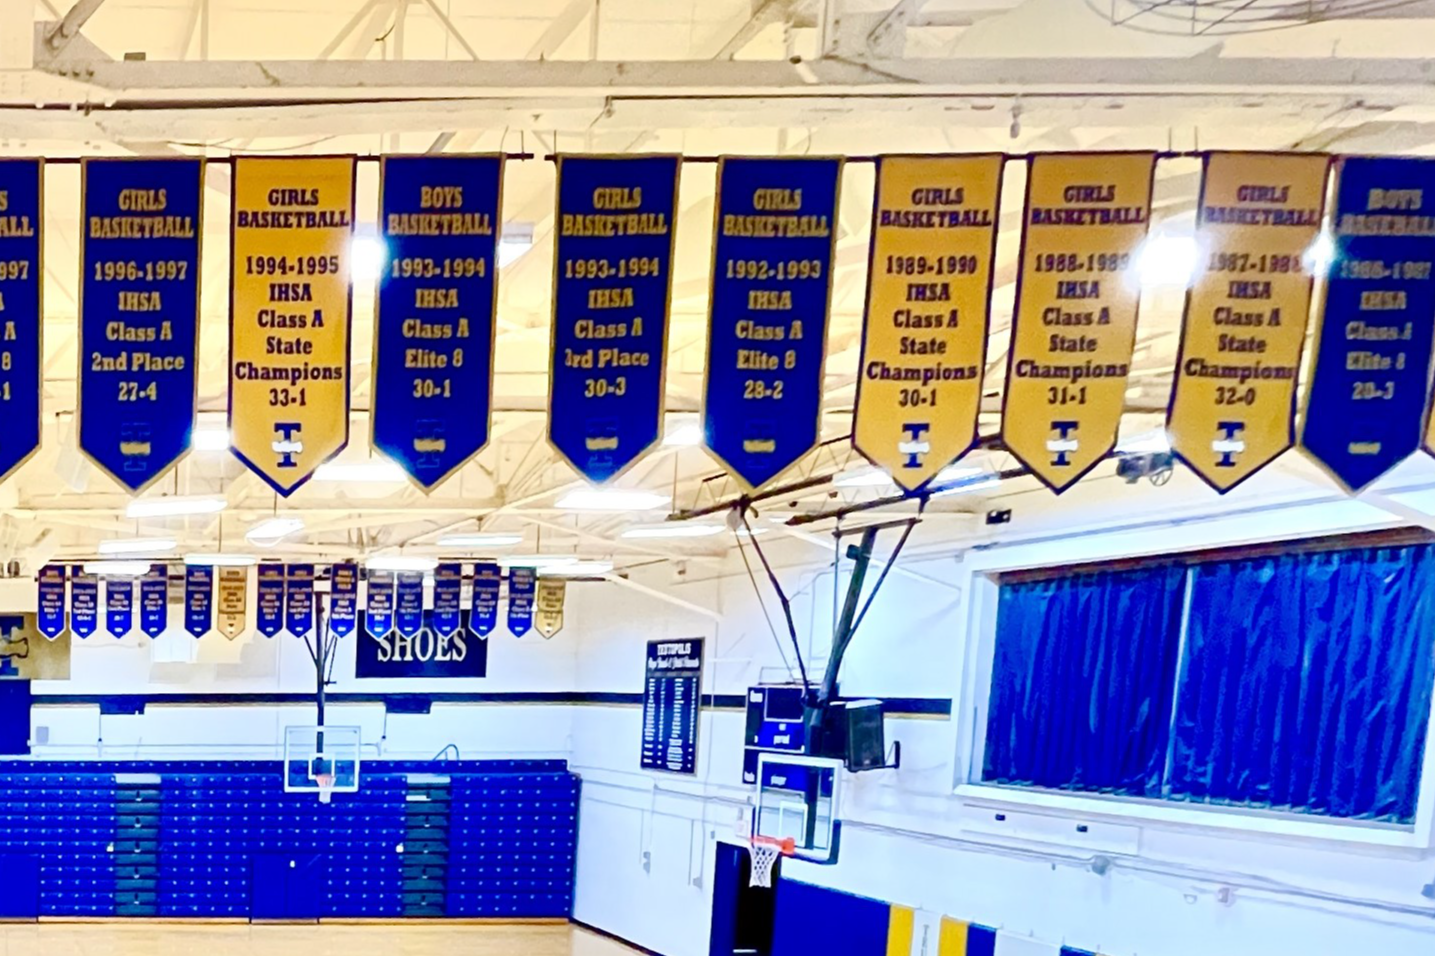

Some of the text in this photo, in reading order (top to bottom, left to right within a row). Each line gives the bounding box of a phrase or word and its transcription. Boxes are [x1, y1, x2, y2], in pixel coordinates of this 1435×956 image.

[119, 189, 166, 211] GIRLS
[268, 189, 318, 206] GIRLS
[421, 186, 462, 208] BOYS
[593, 187, 641, 209] GIRLS
[753, 189, 801, 210] GIRLS
[912, 188, 963, 205] GIRLS
[1064, 185, 1115, 203] GIRLS
[237, 211, 349, 228] BASKETBALL
[387, 213, 492, 235] BASKETBALL
[562, 214, 667, 236] BASKETBALL
[880, 209, 992, 228] BASKETBALL
[1031, 207, 1145, 225] BASKETBALL
[90, 216, 194, 238] BASKETBALL
[723, 215, 829, 237] BASKETBALL
[95, 261, 187, 281] 1996-1997
[247, 256, 338, 275] 1994-1995
[393, 258, 485, 277] 1993-1994
[566, 257, 658, 278] 1993-1994
[727, 260, 821, 280] 1992-1993
[887, 255, 977, 275] 1989-1990
[270, 283, 312, 301] IHSA
[415, 289, 458, 308] IHSA
[588, 288, 633, 308] IHSA
[906, 283, 950, 301] IHSA
[1056, 281, 1099, 299] IHSA
[118, 292, 161, 311] IHSA
[748, 291, 792, 309] IHSA
[258, 310, 323, 328] Class A
[893, 309, 958, 328] Class A
[1042, 307, 1110, 326] Class A
[4, 321, 16, 340] A
[106, 321, 172, 341] Class A
[403, 318, 469, 338] Class A
[575, 317, 642, 338] Class A
[736, 320, 802, 340] Class A
[267, 336, 312, 354] State
[900, 337, 946, 355] State
[1049, 334, 1097, 352] State
[2, 352, 11, 370] 8
[92, 352, 184, 371] 2nd Place
[405, 349, 463, 368] Elite 8
[598, 348, 649, 368] Place
[737, 350, 795, 369] Elite 8
[235, 362, 342, 386] Champions
[867, 361, 978, 386] Champions
[1016, 360, 1128, 384] Champions
[118, 382, 156, 401] 27-4
[413, 379, 450, 397] 30-1
[585, 377, 626, 397] 30-3
[1048, 387, 1086, 405] 31-1
[1215, 386, 1256, 406] 32-0
[270, 388, 306, 406] 33-1
[899, 389, 936, 407] 30-1
[377, 627, 467, 662] SHOES
